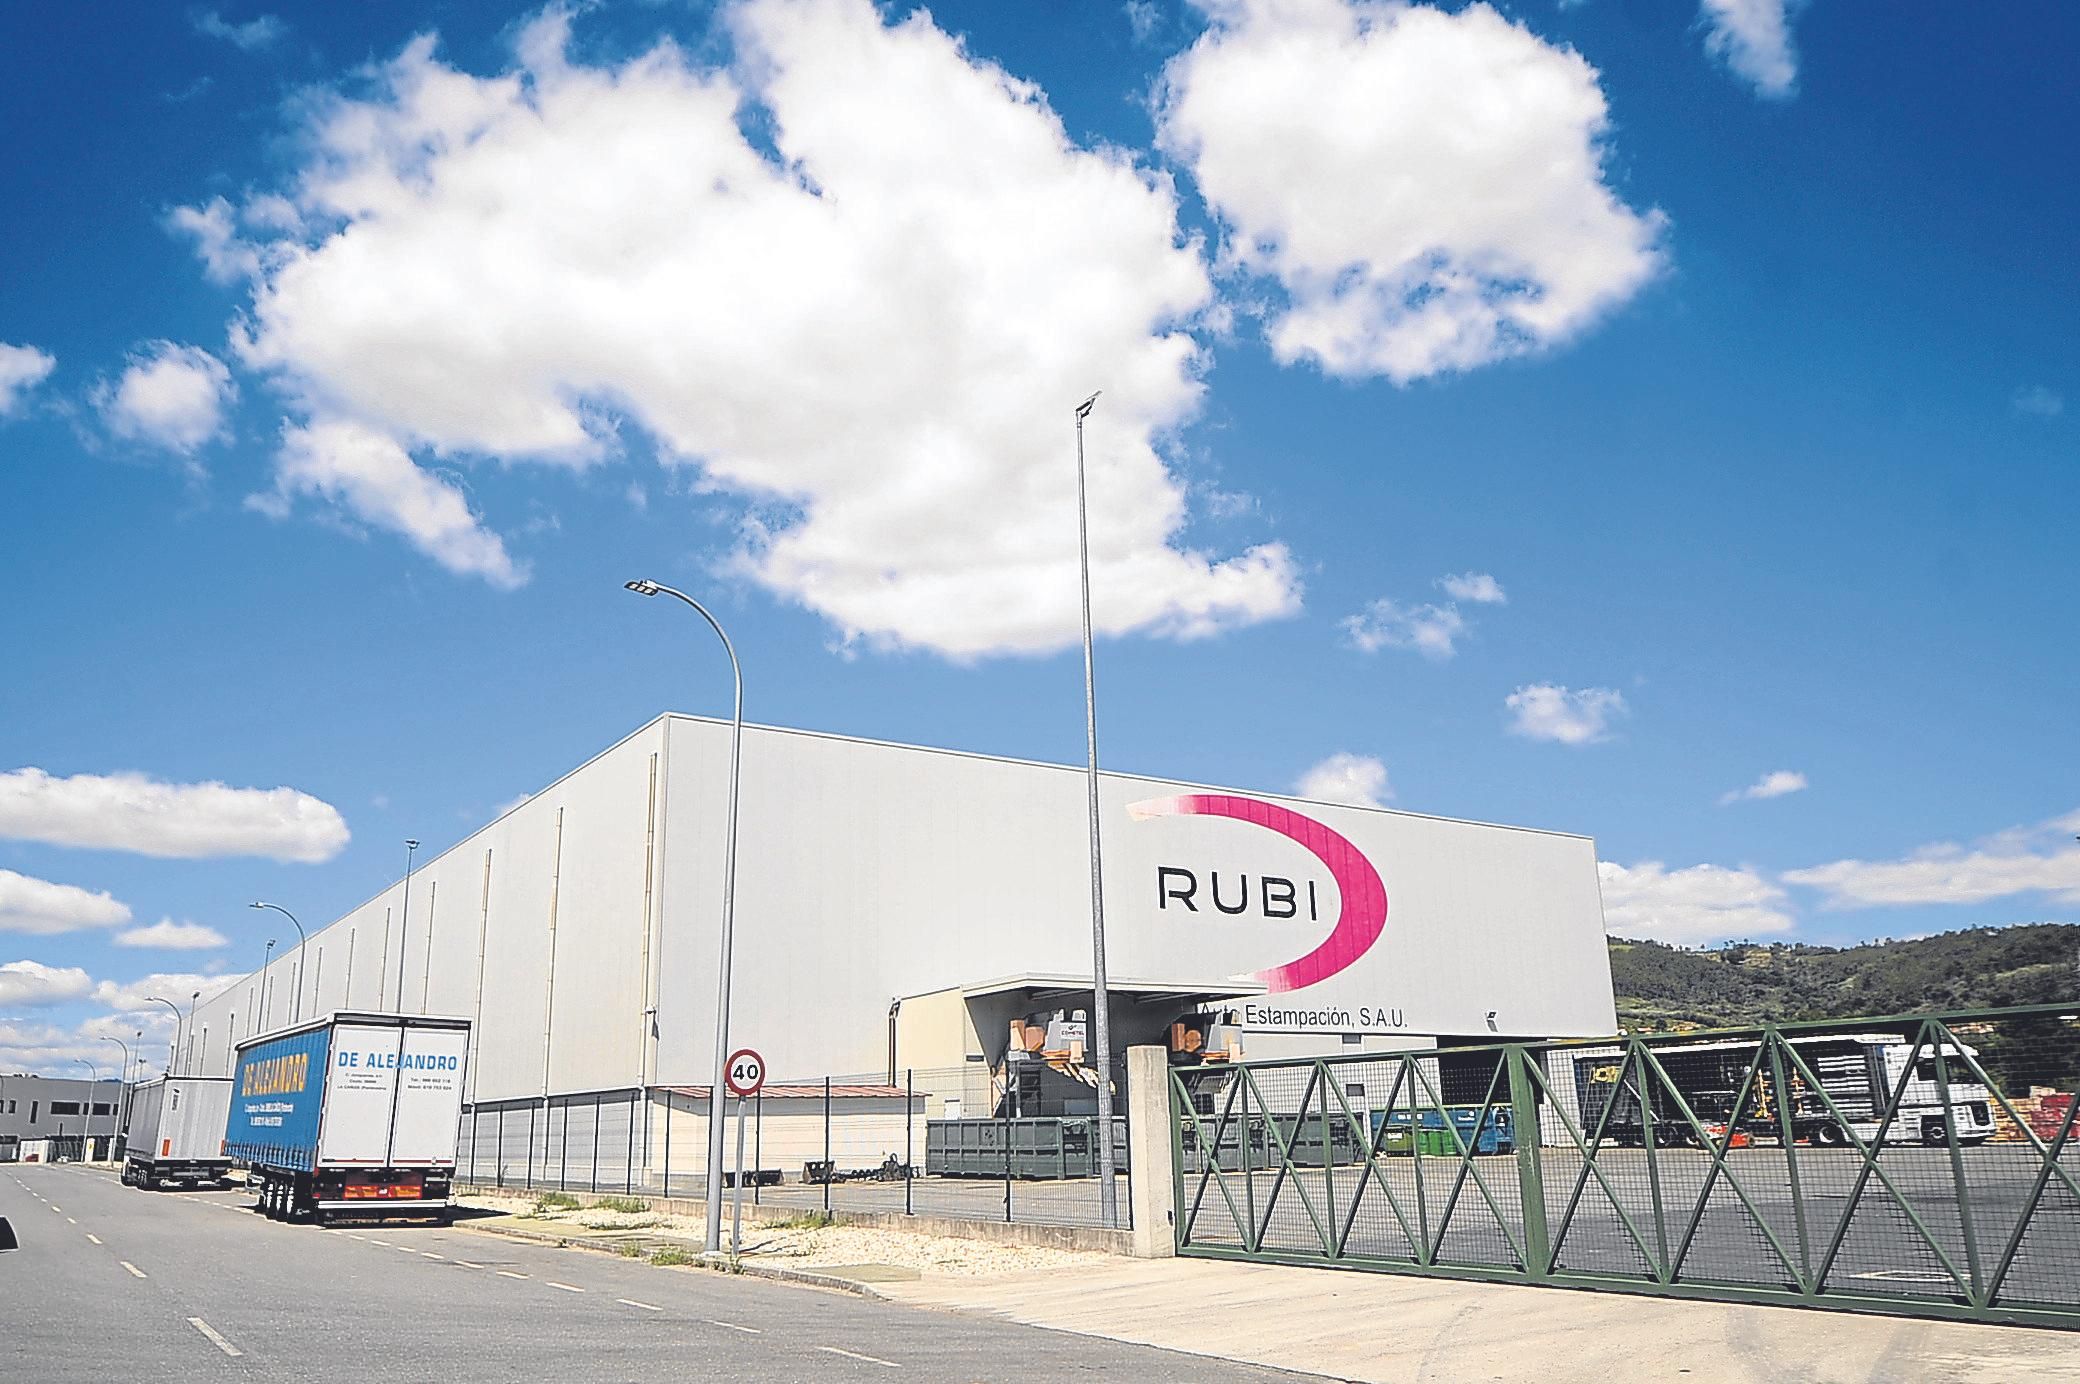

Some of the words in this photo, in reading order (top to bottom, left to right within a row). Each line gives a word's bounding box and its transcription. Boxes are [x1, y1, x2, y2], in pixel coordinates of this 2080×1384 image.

[1158, 866, 1317, 921] RUBI
[1246, 1004, 1355, 1029] Estampación,
[1360, 1007, 1408, 1028] S.A.U.
[338, 1052, 359, 1067] DE
[733, 1064, 759, 1080] 40
